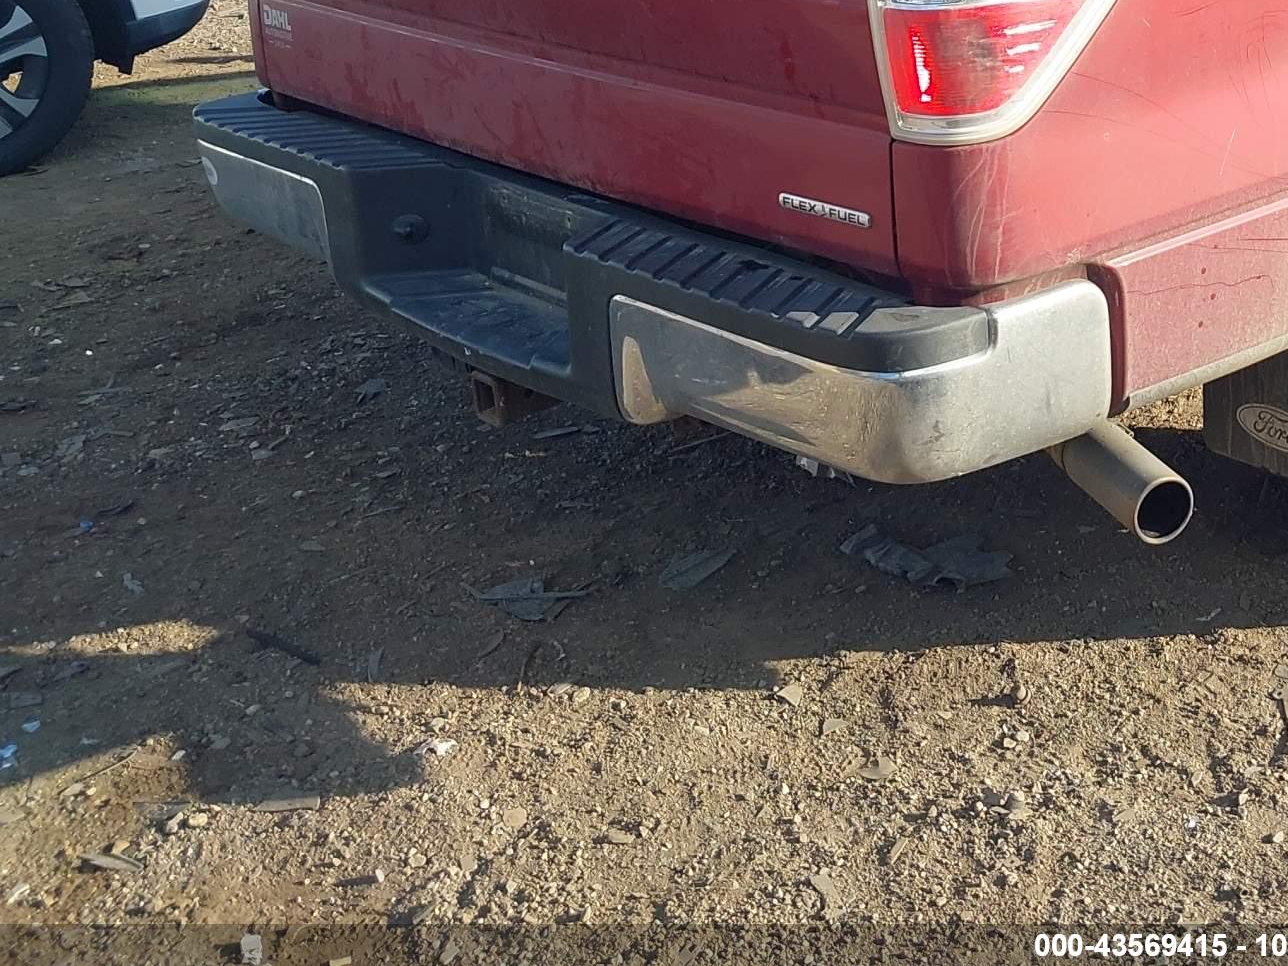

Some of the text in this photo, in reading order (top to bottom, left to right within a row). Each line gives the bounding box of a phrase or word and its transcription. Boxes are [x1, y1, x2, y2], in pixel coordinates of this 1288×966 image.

[263, 3, 292, 32] DAHL
[782, 196, 866, 226] FLEX FUEL
